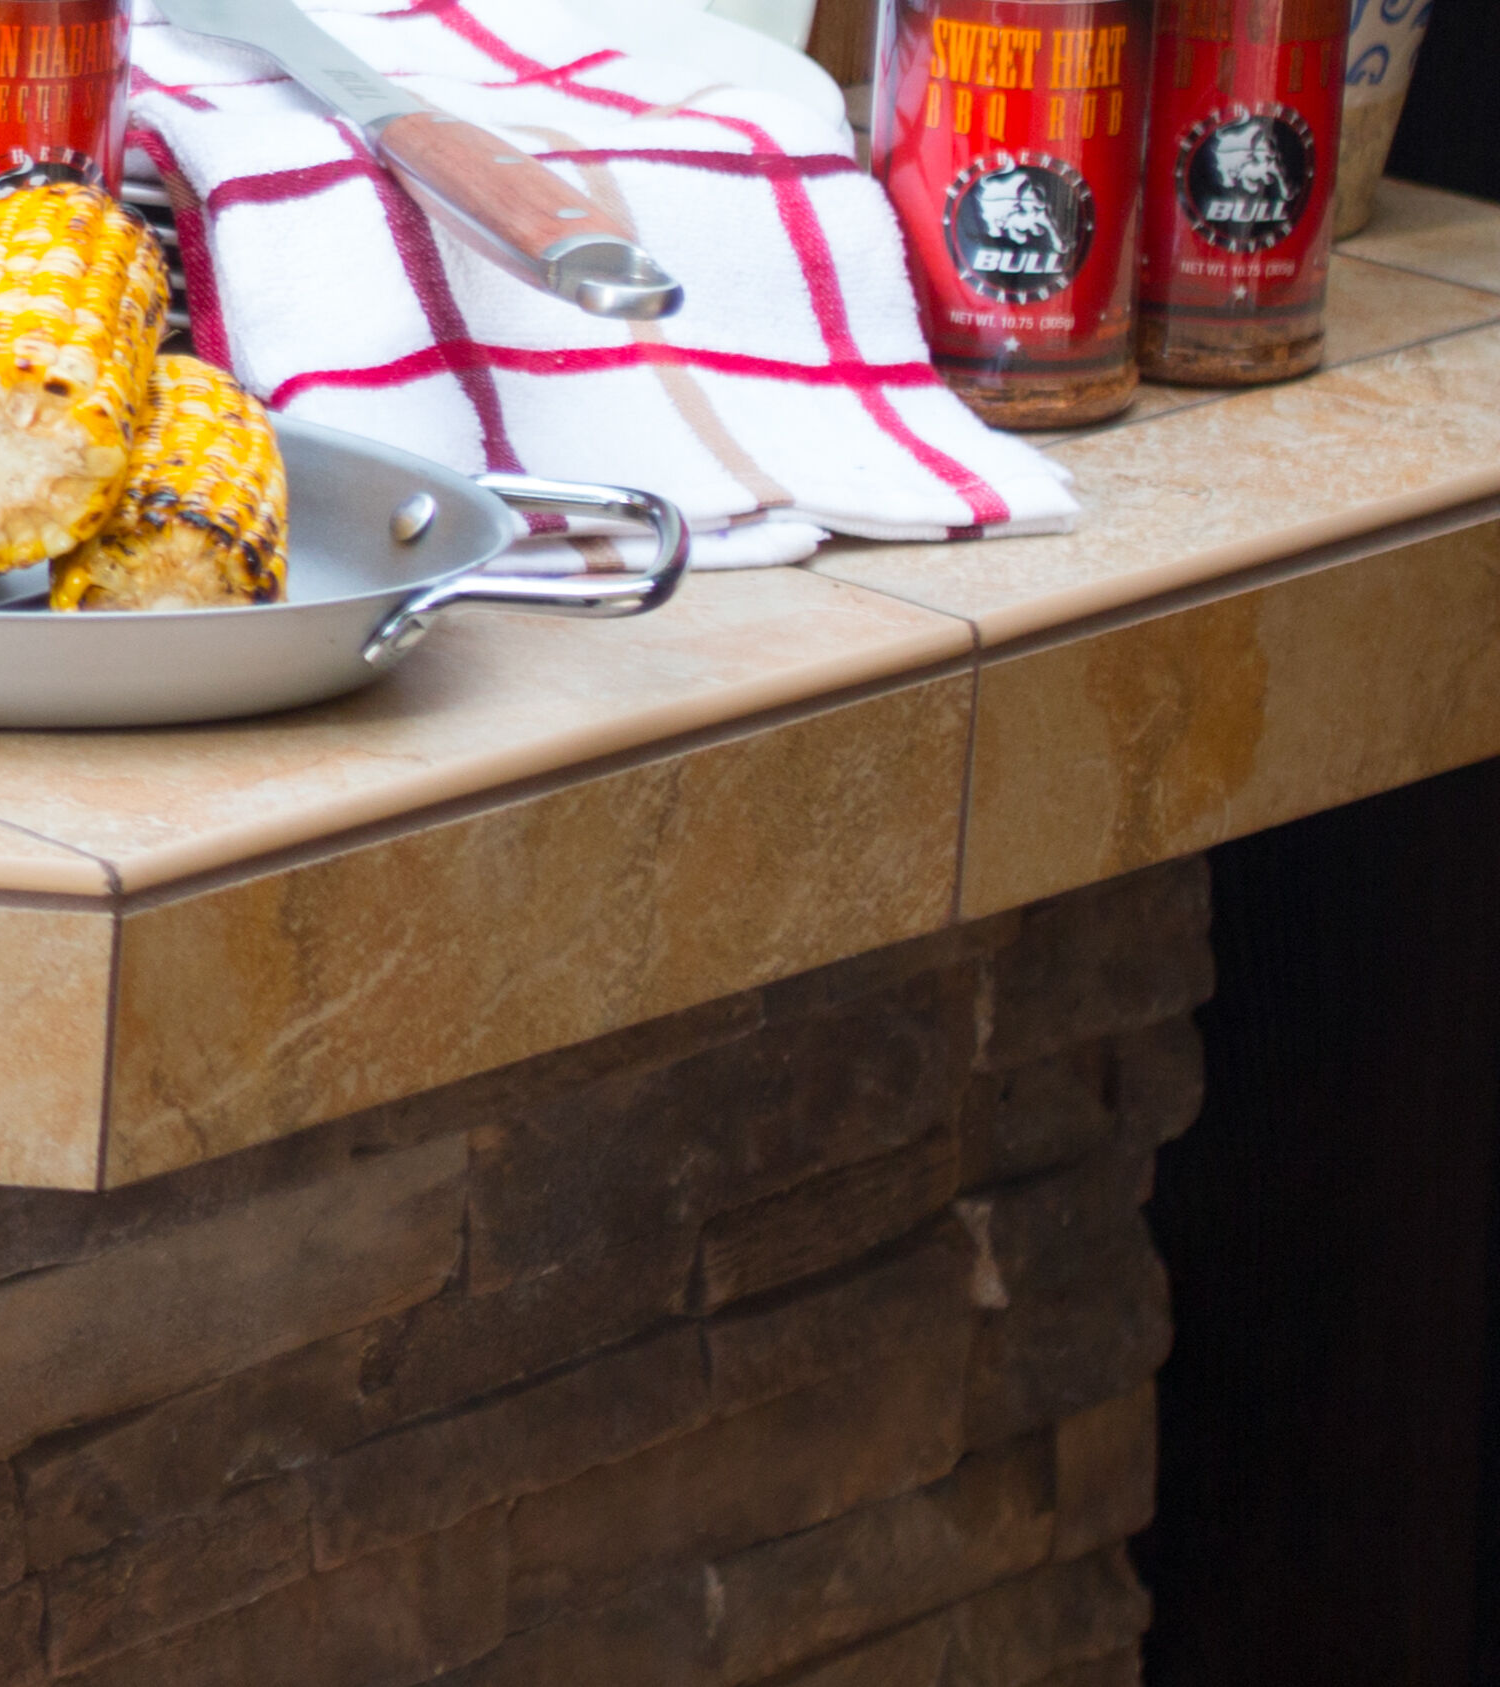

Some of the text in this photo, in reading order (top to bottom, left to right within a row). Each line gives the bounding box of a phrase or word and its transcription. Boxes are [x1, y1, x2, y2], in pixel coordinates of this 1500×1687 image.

[929, 17, 1128, 90] SWEET HEAT
[925, 81, 1124, 143] BBQ RUB
[1205, 199, 1289, 222] BULL
[972, 247, 1064, 274] BULL
[951, 311, 973, 325] NET
[1001, 315, 1034, 330] 10.75
